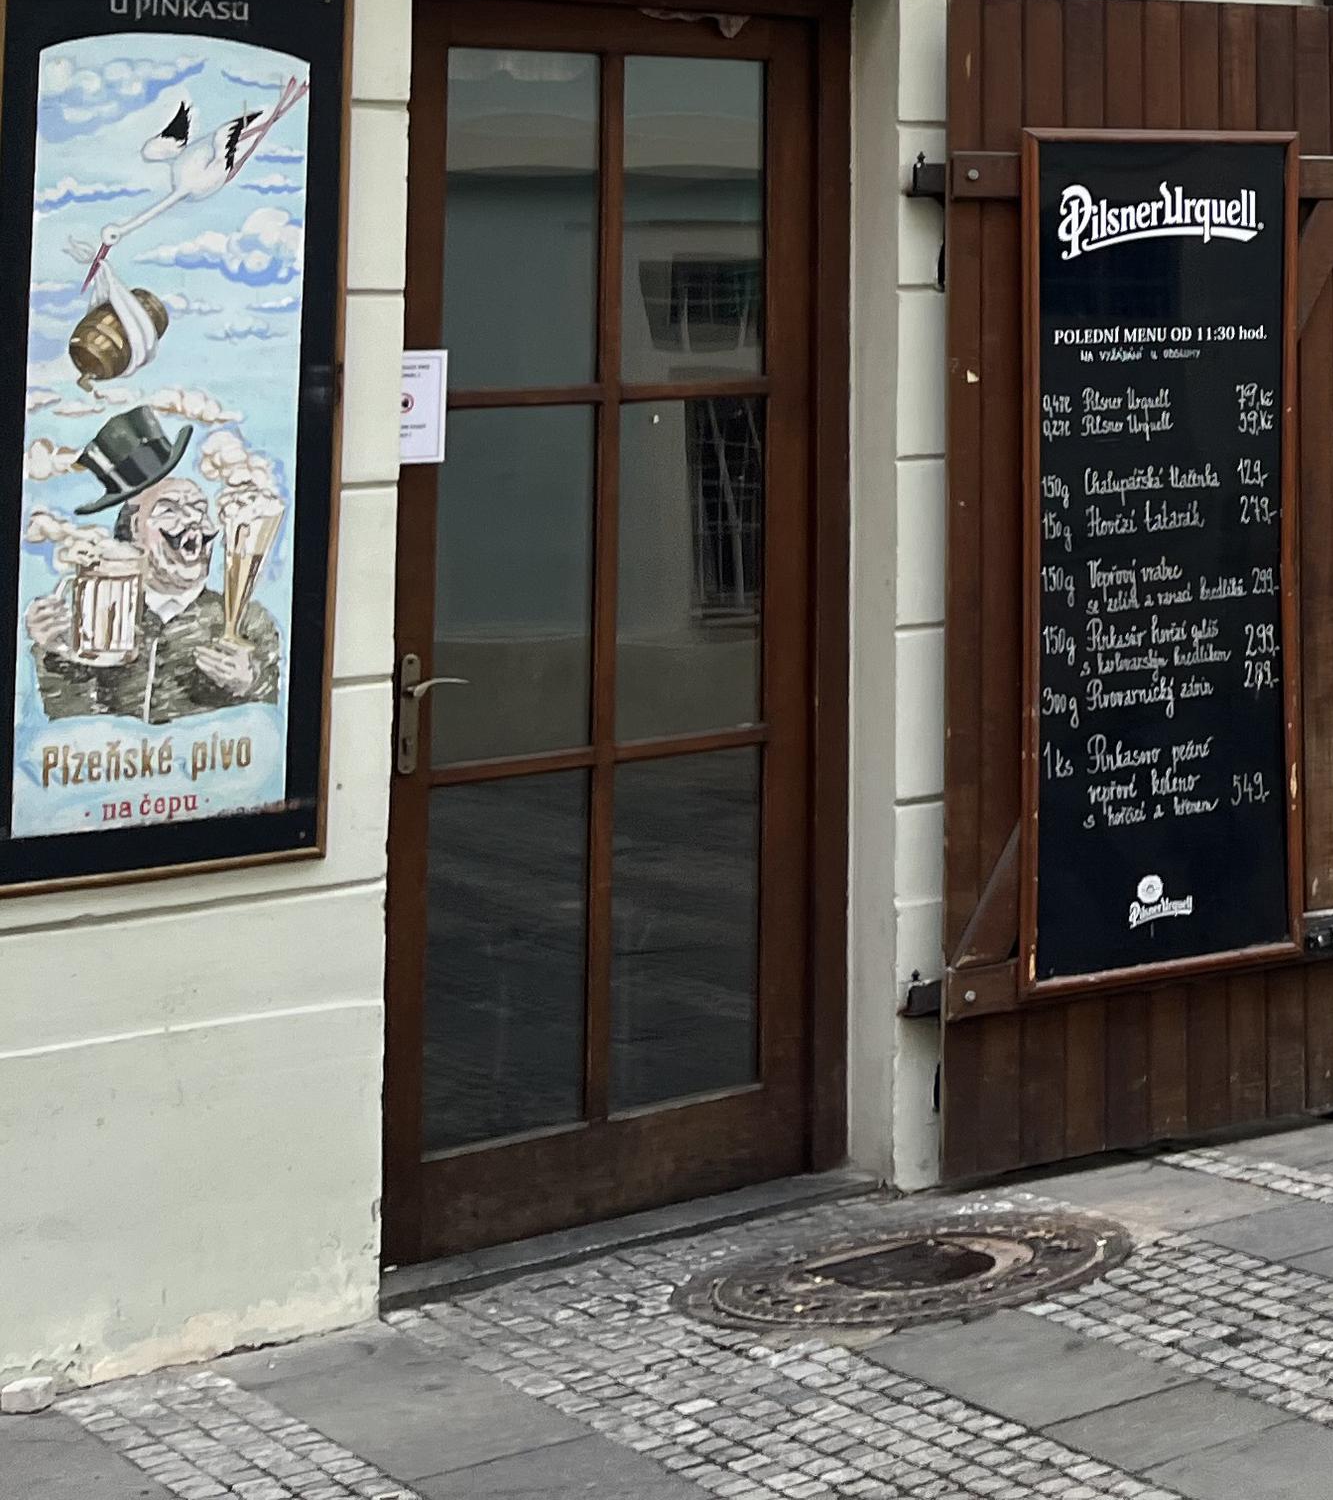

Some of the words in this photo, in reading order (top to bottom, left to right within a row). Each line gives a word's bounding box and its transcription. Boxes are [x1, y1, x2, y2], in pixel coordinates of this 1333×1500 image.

[1057, 183, 1164, 261] Pilsner
[1160, 181, 1256, 244] Urquell
[1054, 325, 1120, 346] POLEDNÍ
[1123, 326, 1167, 343] MENU
[1170, 326, 1193, 342] OD
[1197, 325, 1236, 341] 11:30
[1238, 324, 1268, 341] hod.
[1082, 386, 1123, 412] Pilsner
[1126, 385, 1171, 419] Urquell
[1080, 414, 1124, 437] Pilsner
[1126, 411, 1174, 442] Urquell
[41, 735, 174, 789] Plzeňské
[190, 731, 252, 782] pivo
[102, 801, 132, 822] na
[139, 792, 198, 821] čepu
